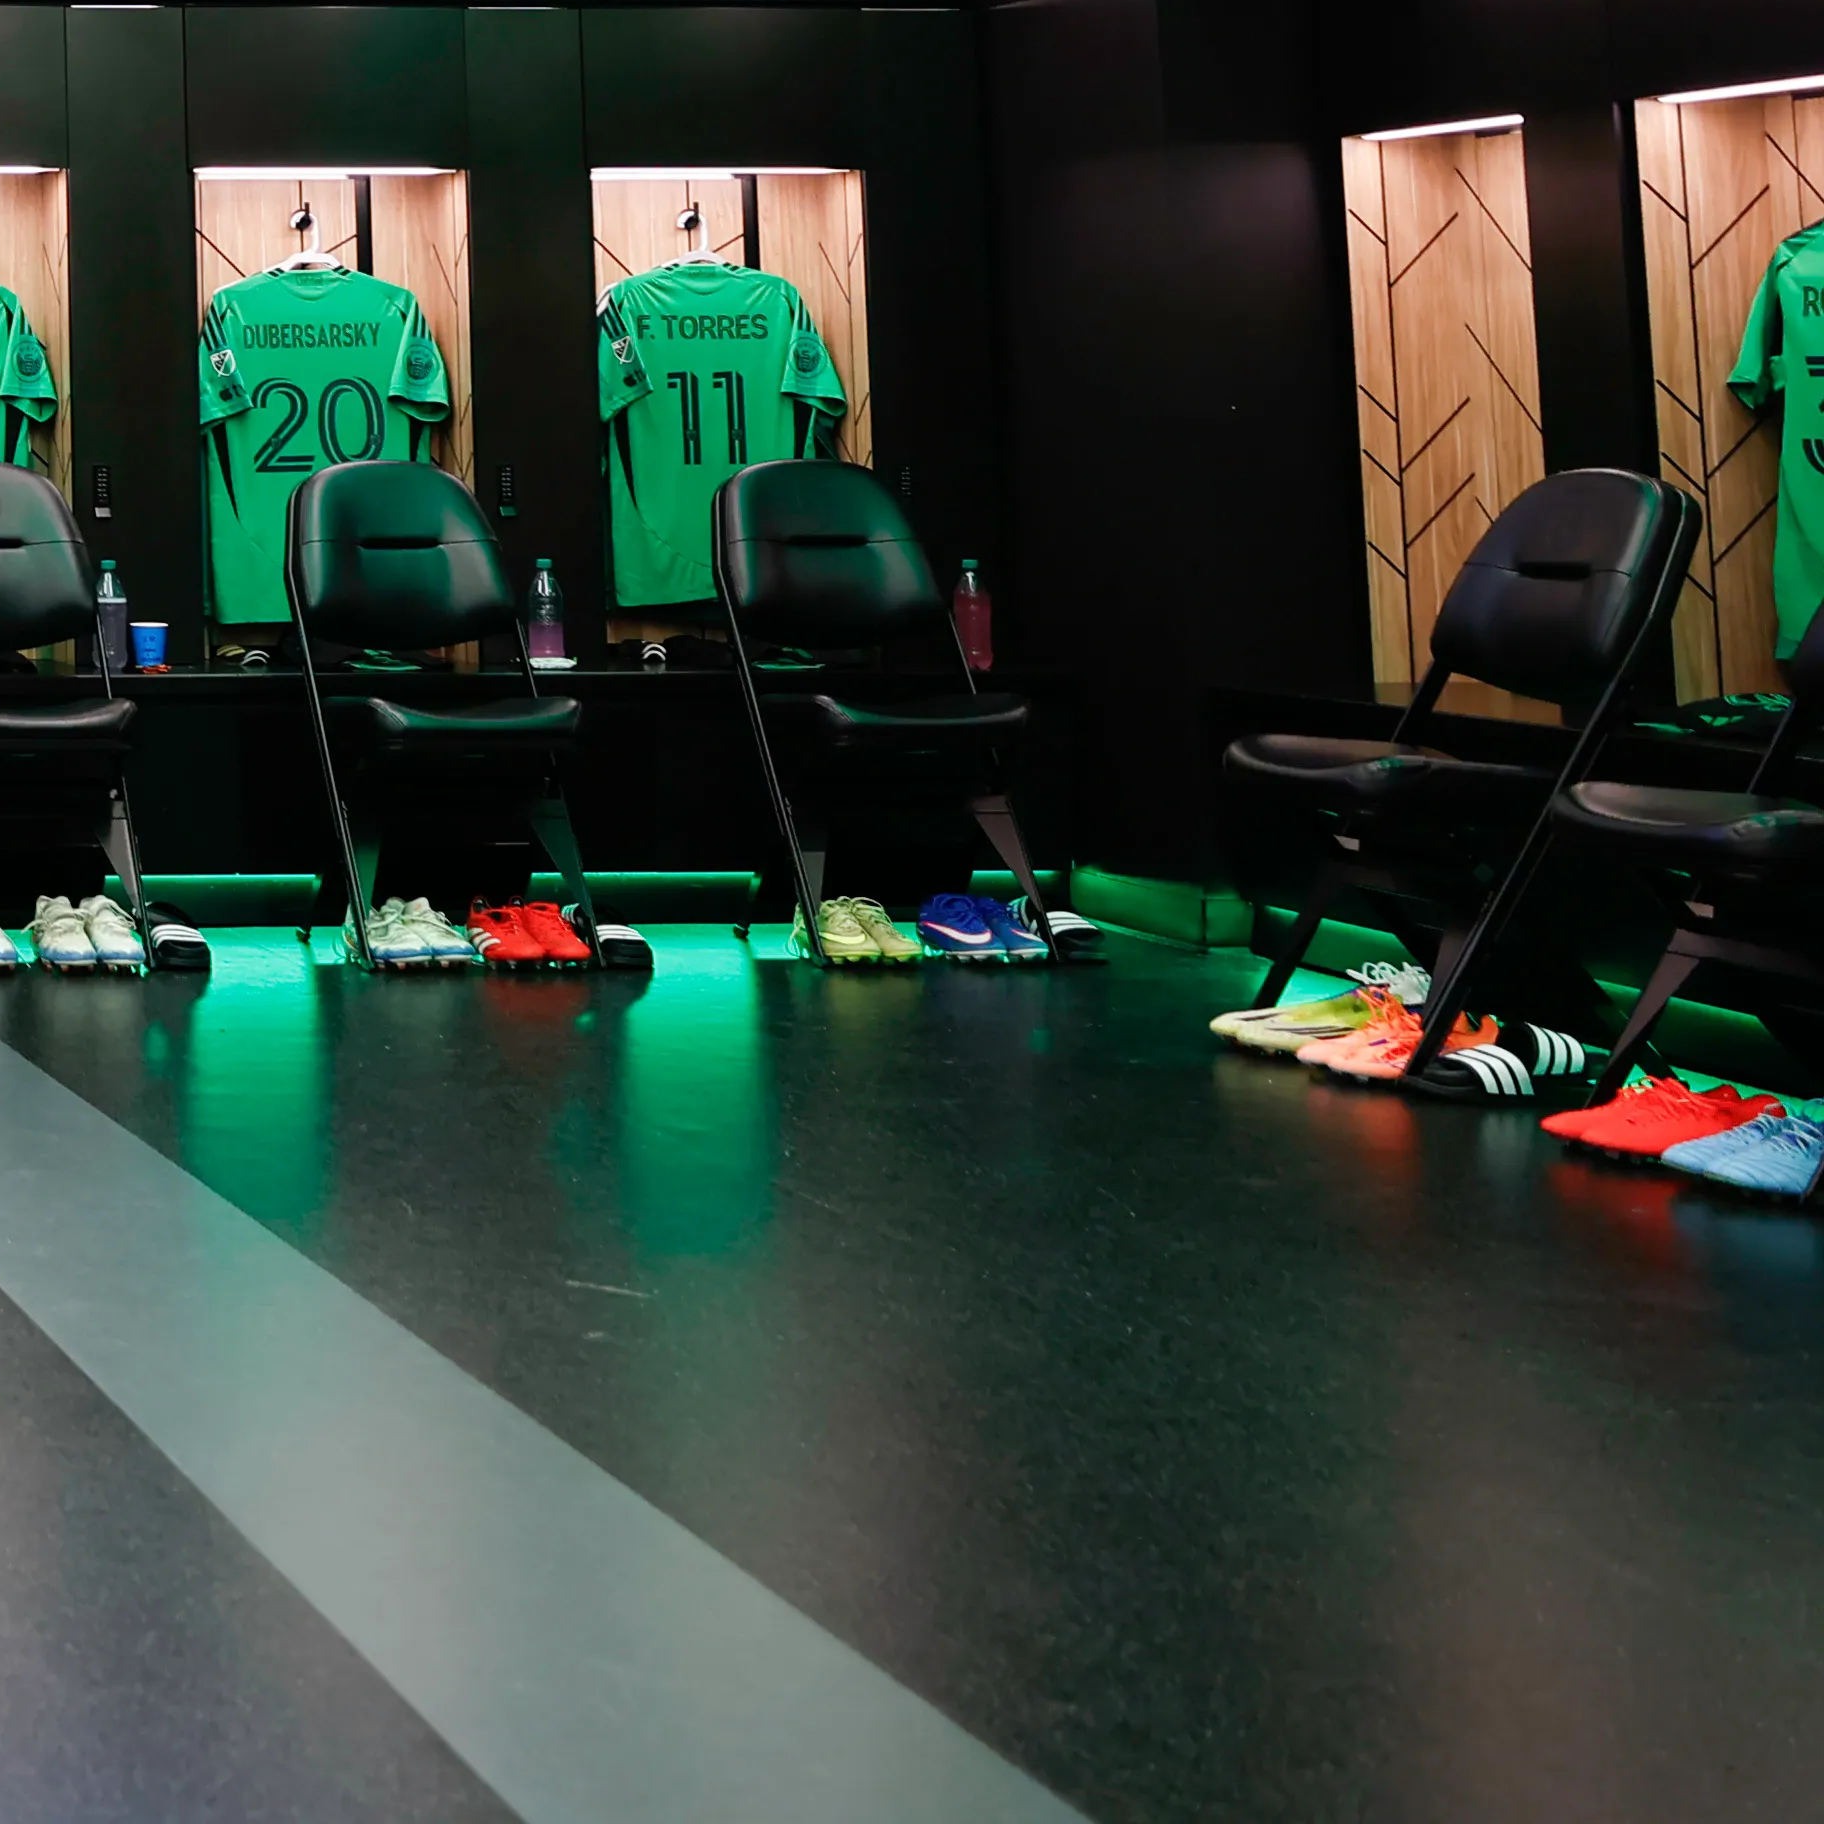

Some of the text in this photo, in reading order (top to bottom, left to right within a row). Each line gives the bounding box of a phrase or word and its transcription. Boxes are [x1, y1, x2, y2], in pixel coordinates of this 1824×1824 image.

[242, 322, 382, 350] DUBERSARSKY
[636, 314, 768, 340] F. TORRES
[251, 377, 386, 474] 20
[666, 370, 748, 465] 11
